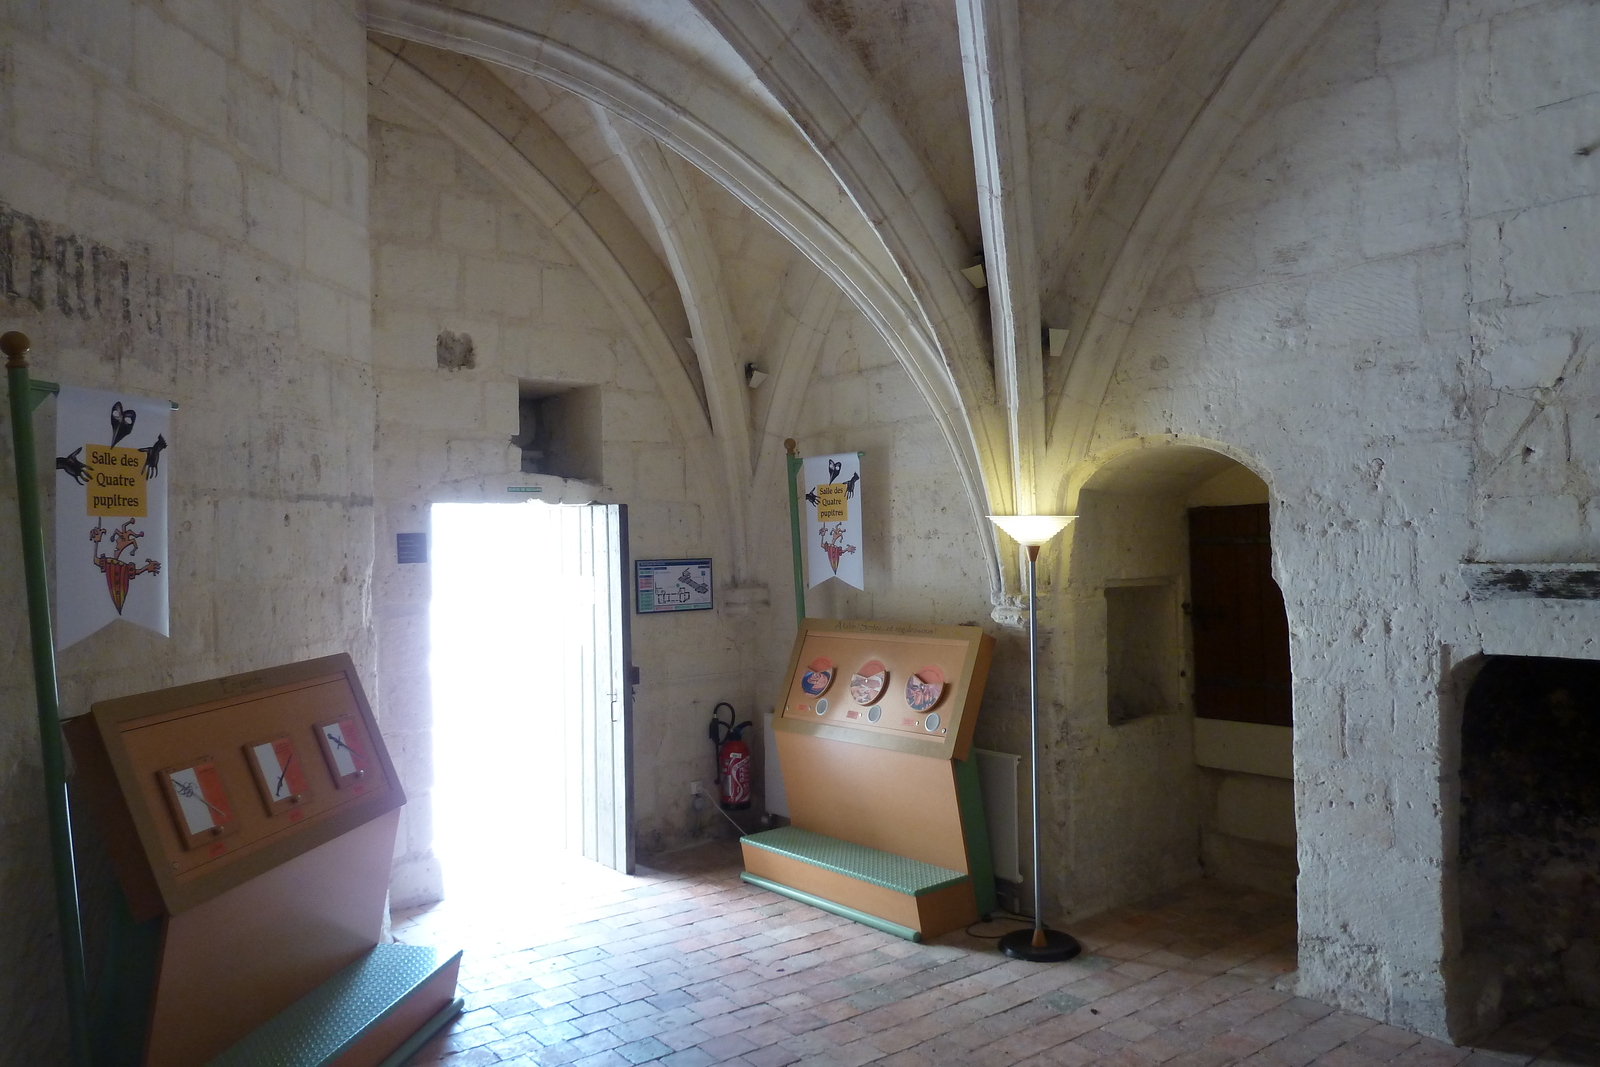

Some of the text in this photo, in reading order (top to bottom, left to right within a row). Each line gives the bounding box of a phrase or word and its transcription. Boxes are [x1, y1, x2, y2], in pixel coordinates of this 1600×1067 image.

[92, 451, 139, 467] Salle des
[96, 472, 135, 488] Quatre
[820, 487, 833, 495] Salle
[93, 494, 139, 509] pupitres
[821, 509, 843, 518] pupitres
